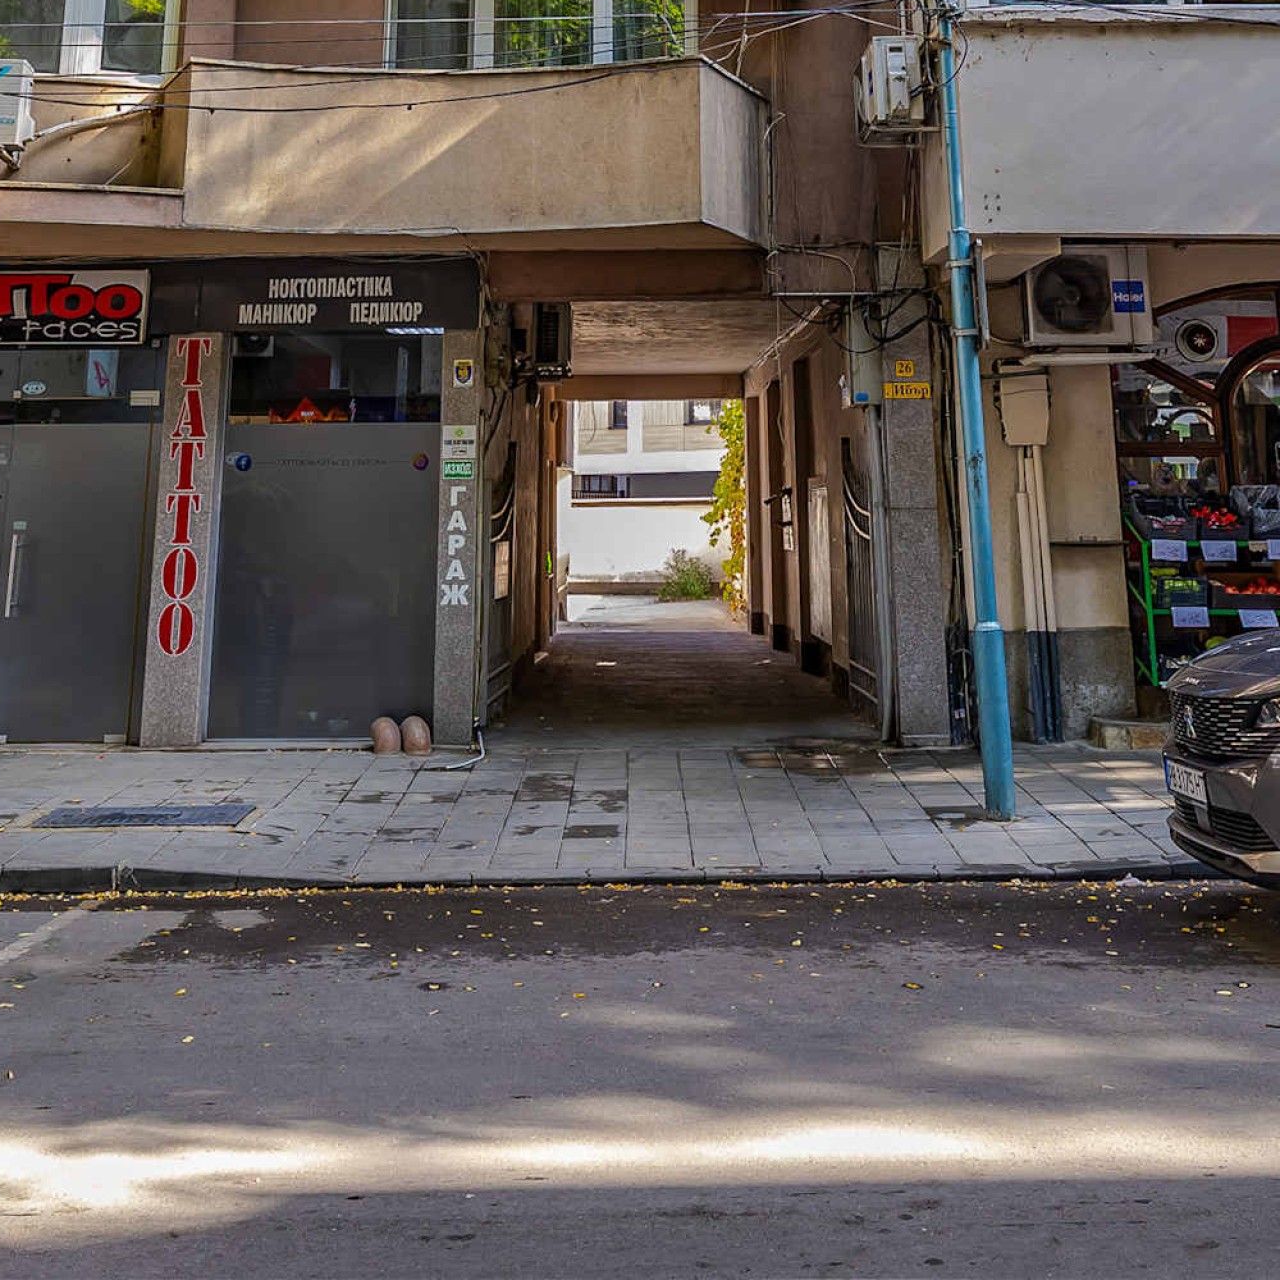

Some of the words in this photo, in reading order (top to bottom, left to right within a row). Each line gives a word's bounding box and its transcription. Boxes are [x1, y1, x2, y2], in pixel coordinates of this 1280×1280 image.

[269, 276, 393, 299] НОКТОПЛАСТИКА
[238, 303, 317, 325] МАНИКЮР
[350, 302, 423, 325] ПЕДИКЮР
[897, 362, 912, 374] 26
[158, 337, 211, 656] TATTOO
[440, 485, 470, 605] ГАРАЖ
